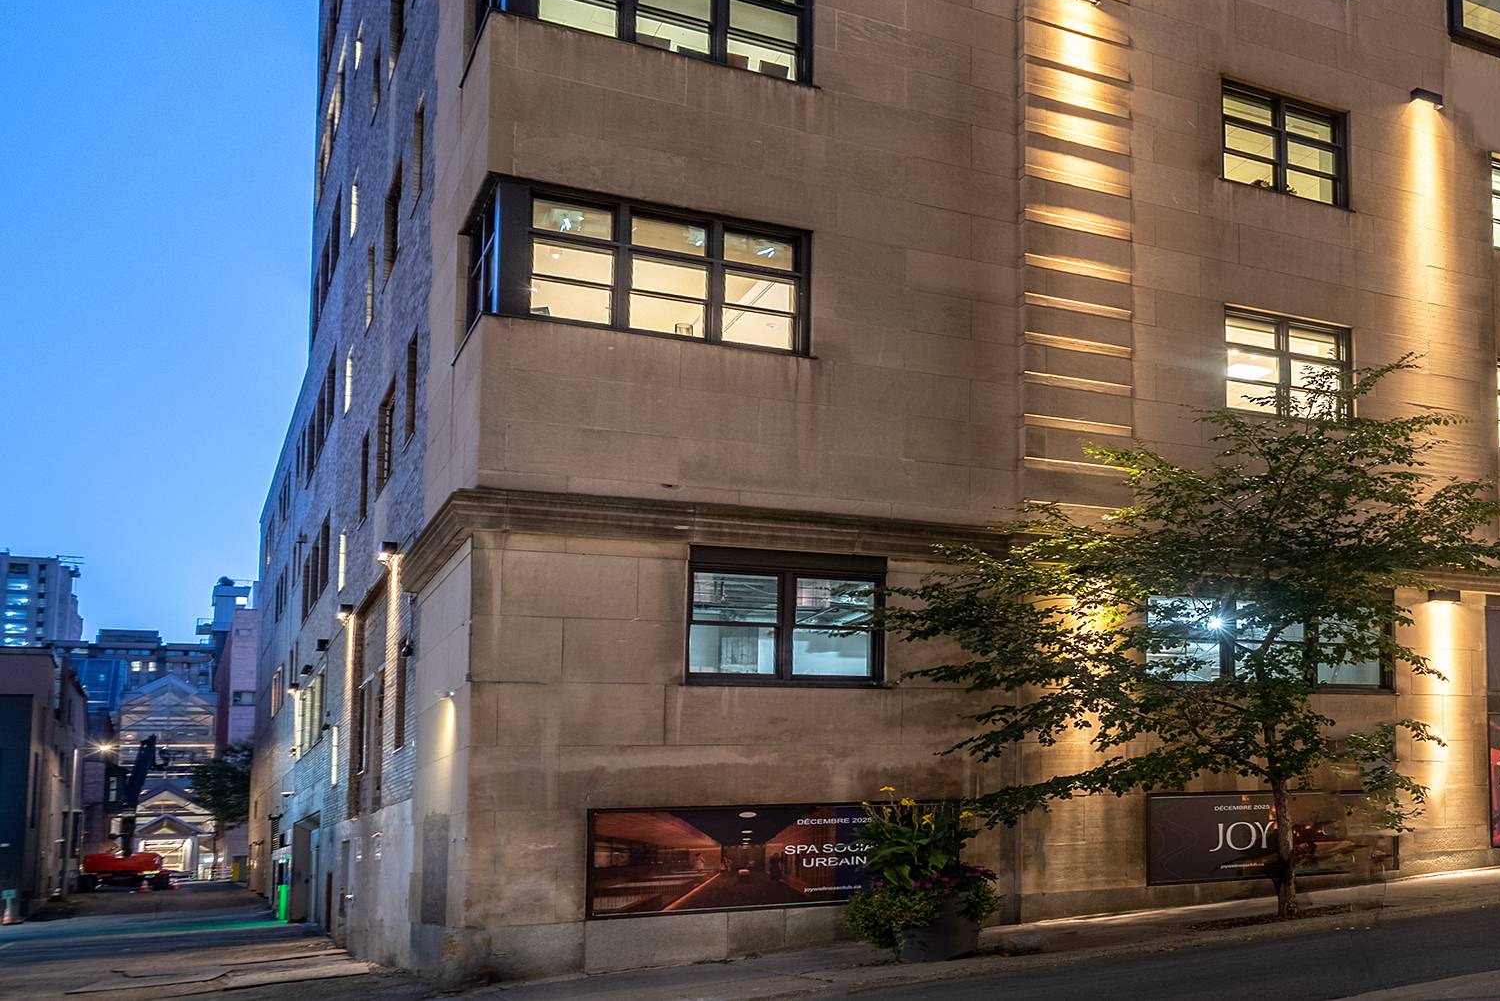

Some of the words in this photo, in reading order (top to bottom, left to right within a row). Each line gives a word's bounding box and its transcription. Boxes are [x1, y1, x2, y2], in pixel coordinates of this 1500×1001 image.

[796, 817, 850, 826] DÉCEMBRE
[1208, 821, 1274, 852] JOY
[784, 844, 819, 855] SPA
[822, 842, 879, 854] SOCIA
[802, 855, 868, 868] URBAIN
